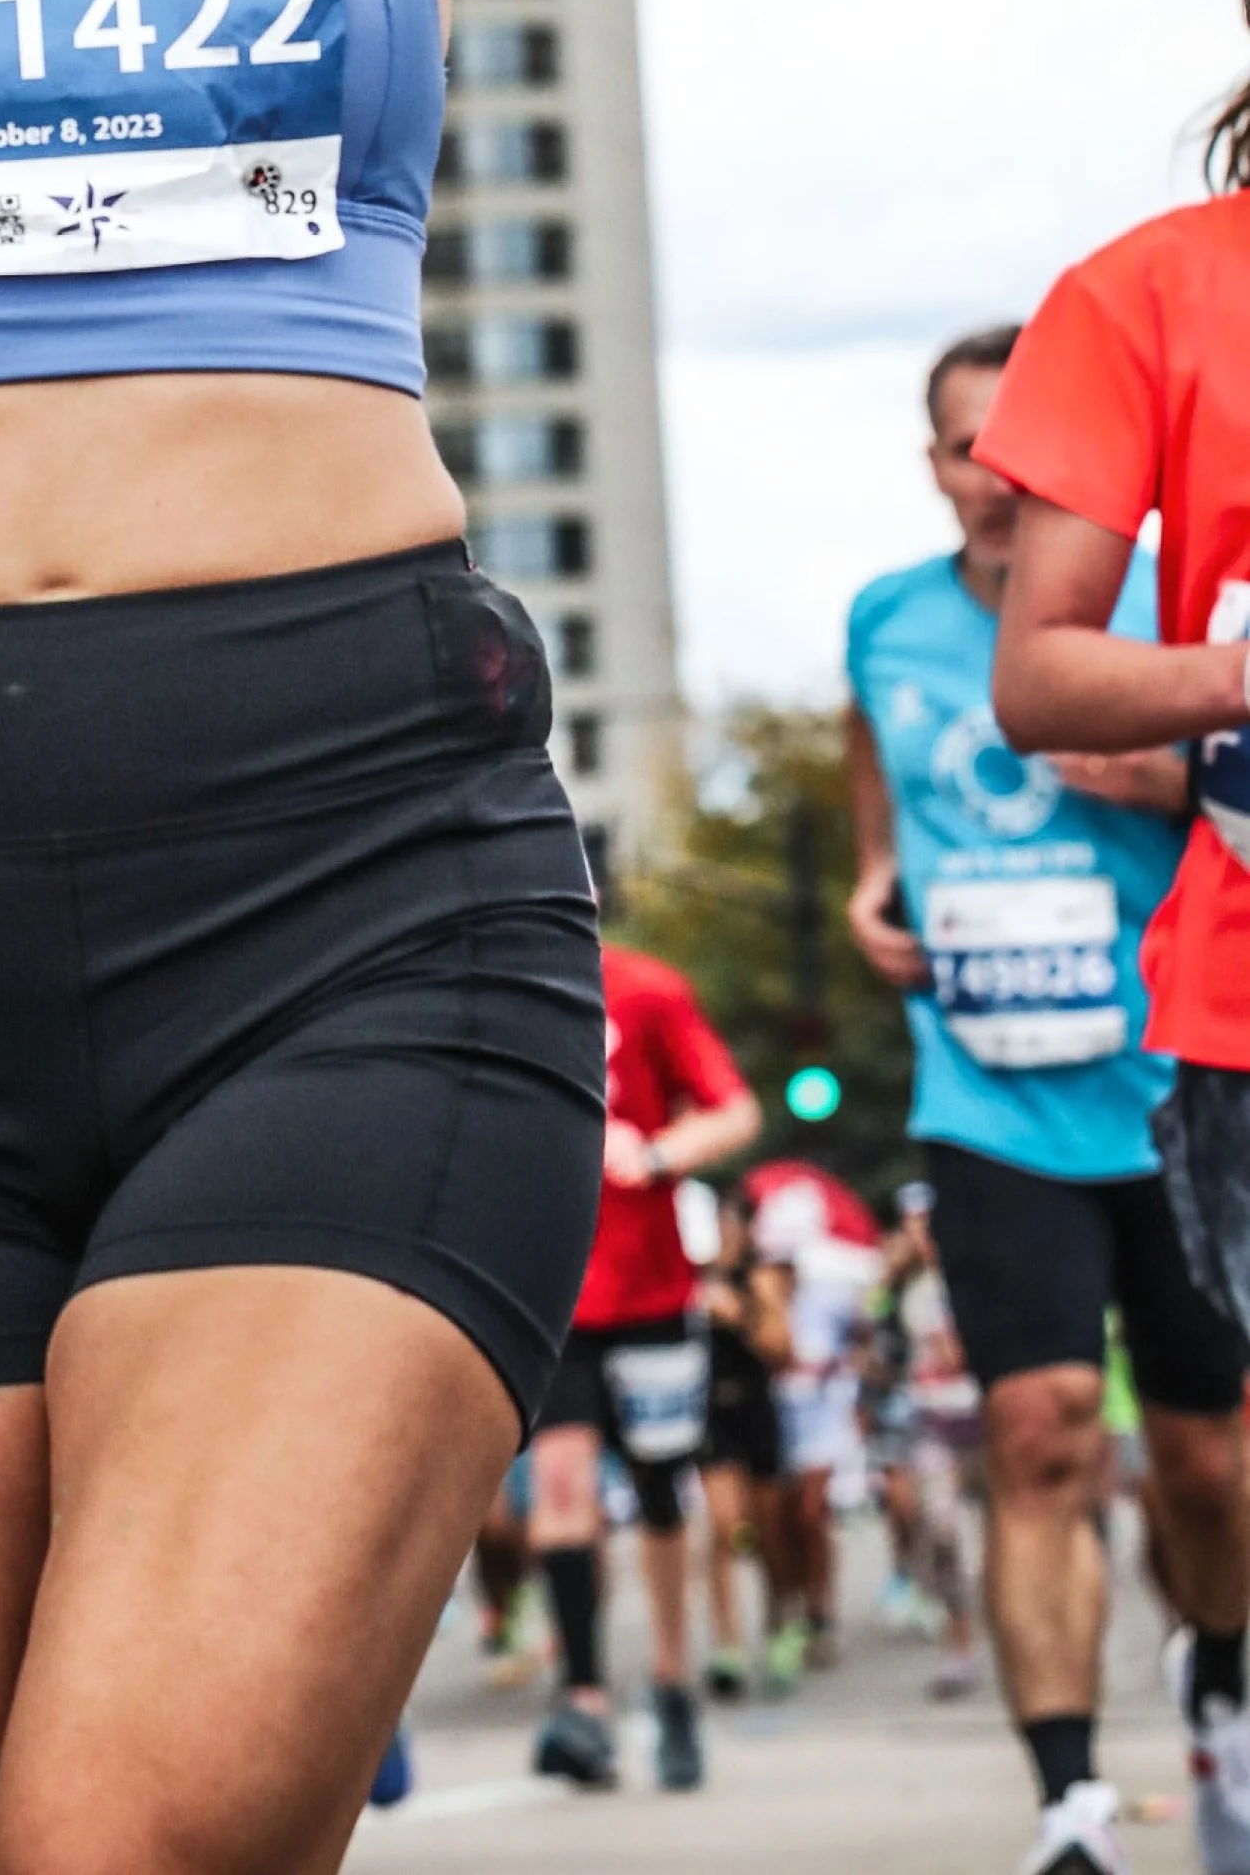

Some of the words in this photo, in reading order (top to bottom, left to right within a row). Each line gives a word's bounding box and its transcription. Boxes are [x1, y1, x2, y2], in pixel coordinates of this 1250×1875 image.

[60, 117, 87, 146] 8,
[92, 113, 163, 141] 2023
[265, 189, 317, 215] 829
